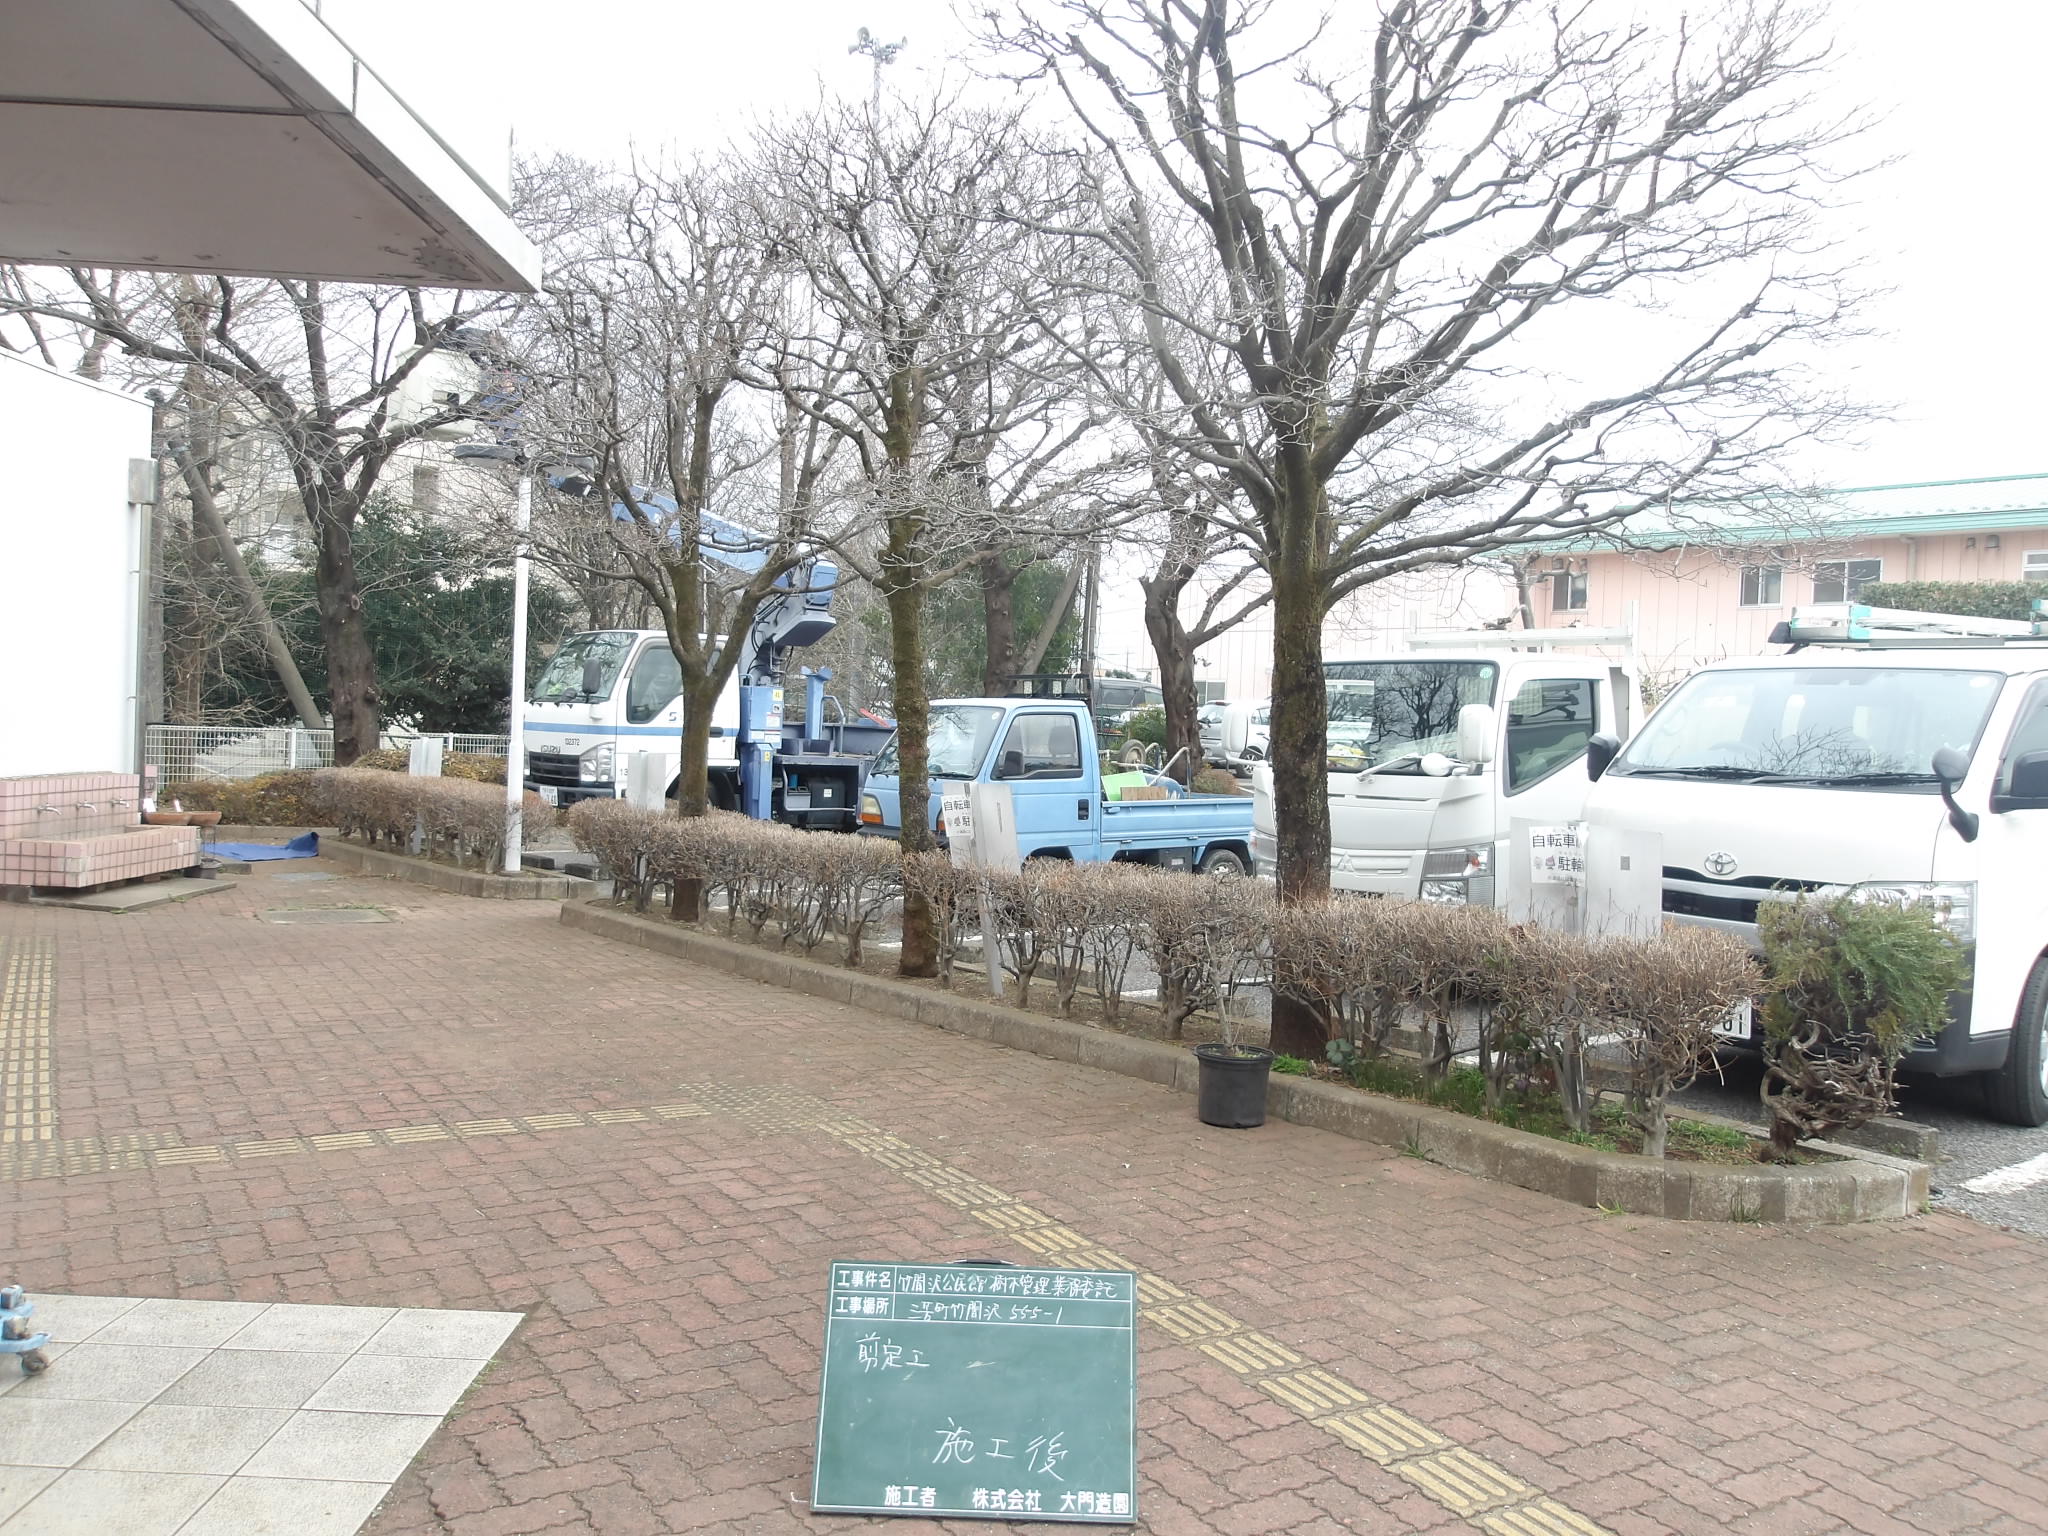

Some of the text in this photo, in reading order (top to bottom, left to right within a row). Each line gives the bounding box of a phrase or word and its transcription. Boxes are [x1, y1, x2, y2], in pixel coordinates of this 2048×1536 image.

[837, 1270, 891, 1289] 工事件名
[835, 1296, 890, 1316] 工事場所
[1009, 1304, 1064, 1325] 555-1
[855, 1332, 930, 1373] 剪定工
[932, 1417, 1070, 1482] 施工後
[885, 1485, 1130, 1514] 施工者 株式会社 大門造園
